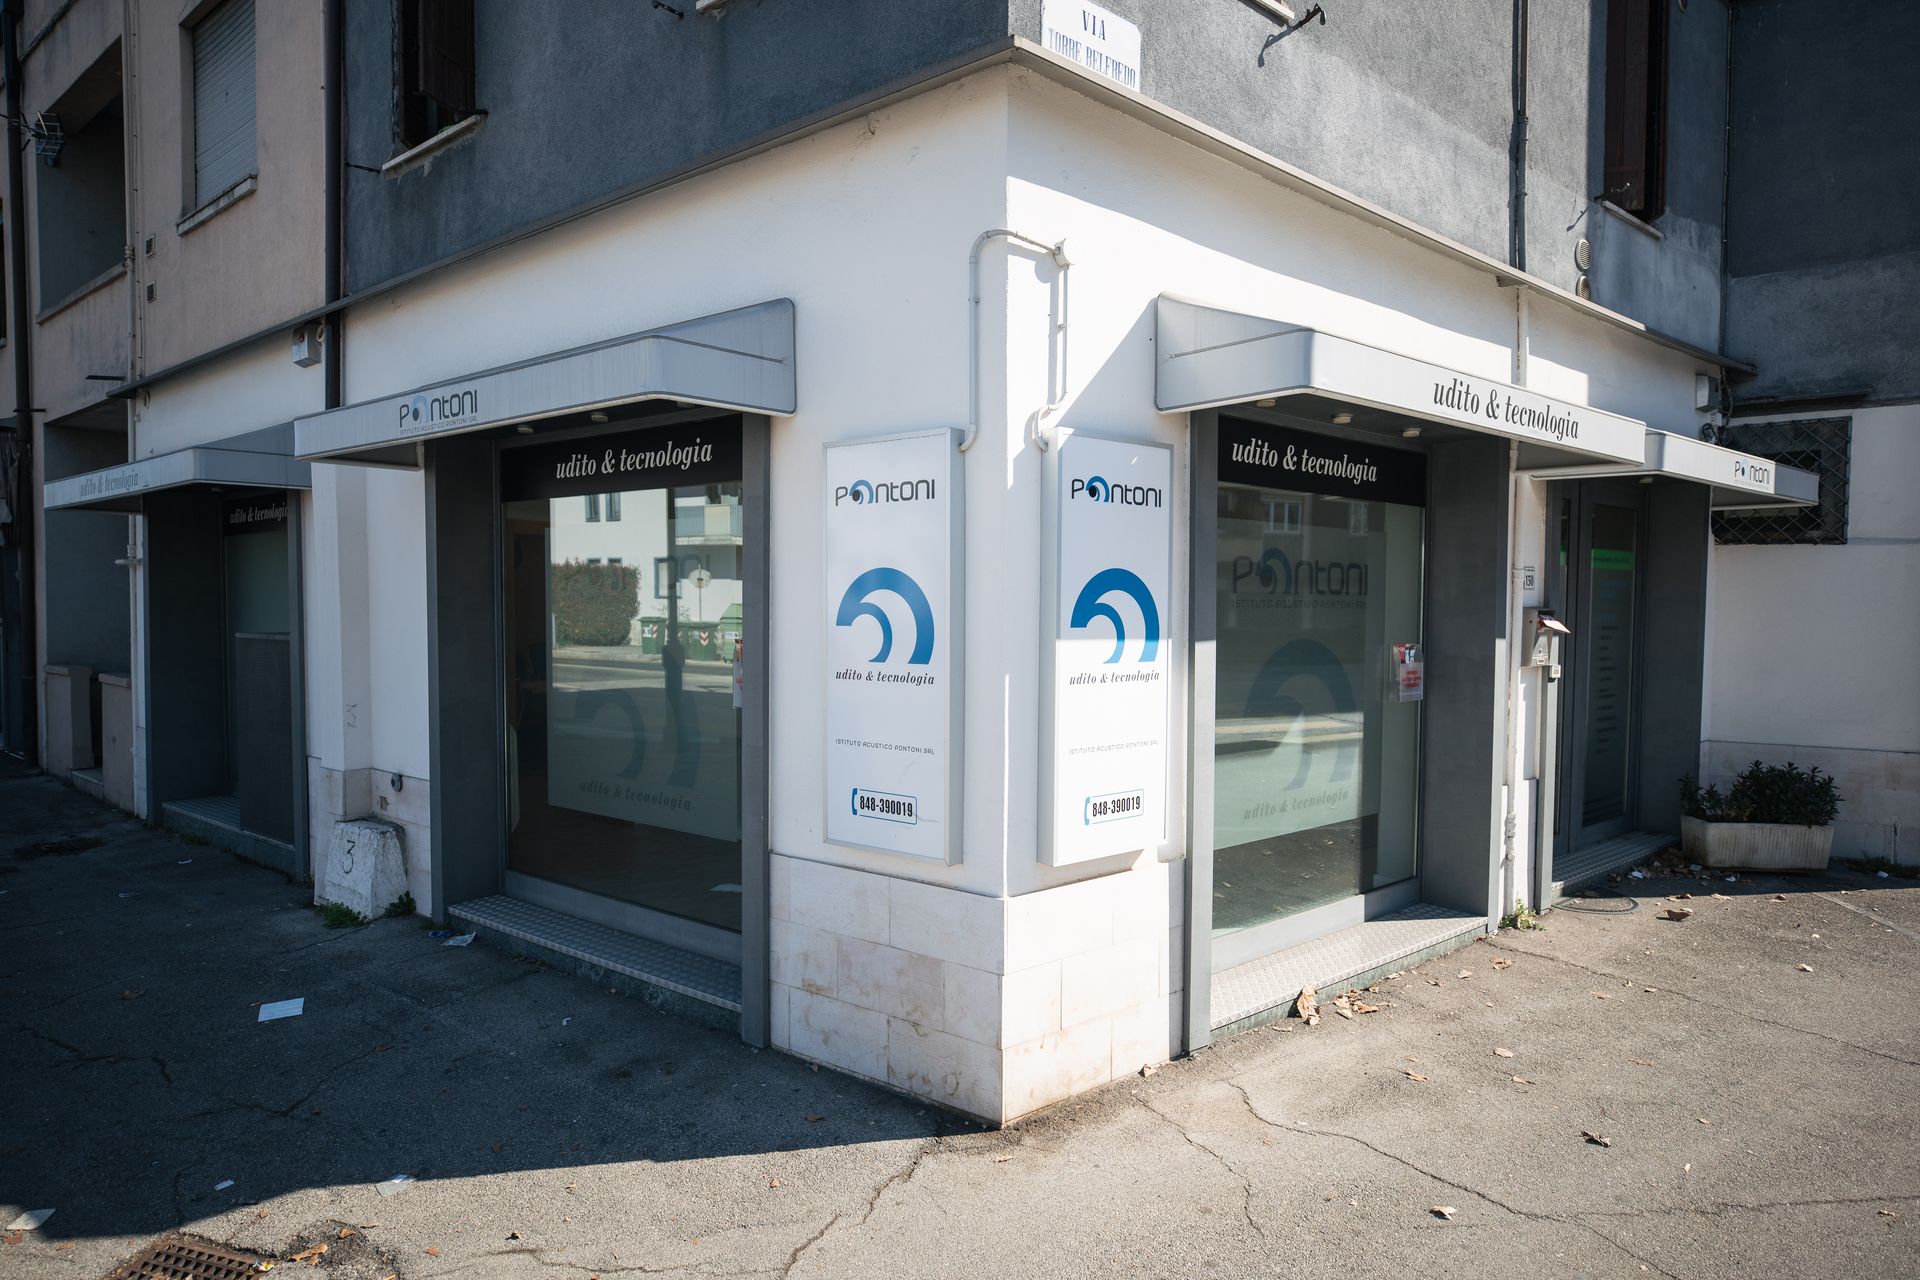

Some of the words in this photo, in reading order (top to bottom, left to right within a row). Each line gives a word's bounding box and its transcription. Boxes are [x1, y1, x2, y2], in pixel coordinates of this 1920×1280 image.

[1082, 10, 1106, 41] VIA
[1048, 28, 1082, 64] TORRE
[1086, 46, 1136, 88] BELFREDO
[1433, 378, 1480, 414] udito
[1486, 389, 1499, 419] &
[1505, 396, 1579, 441] tecnologia
[556, 454, 596, 479] udito
[601, 449, 615, 474] &
[620, 437, 713, 471] tecnologia
[1232, 438, 1278, 467] udito
[1283, 444, 1297, 471] &
[1301, 449, 1378, 485] tecnologia
[835, 668, 862, 681] udito
[865, 670, 874, 682] &
[877, 670, 935, 686] tecnologia
[1069, 672, 1097, 686] udito
[1100, 673, 1108, 684] &
[1111, 669, 1160, 684] tecnologia
[835, 738, 861, 747] ISTITUTO
[862, 741, 893, 751] ACUSTICO
[895, 744, 922, 754] PONTONI
[1068, 746, 1095, 756] ISTITUTO
[579, 780, 609, 794] udito
[613, 784, 622, 799] &
[625, 788, 691, 811] tecnologia
[860, 795, 913, 817] 848-390019
[1092, 795, 1141, 817] 848-390019
[1244, 802, 1276, 820] udito
[1280, 800, 1288, 813] &
[1292, 788, 1349, 810] tecnologia
